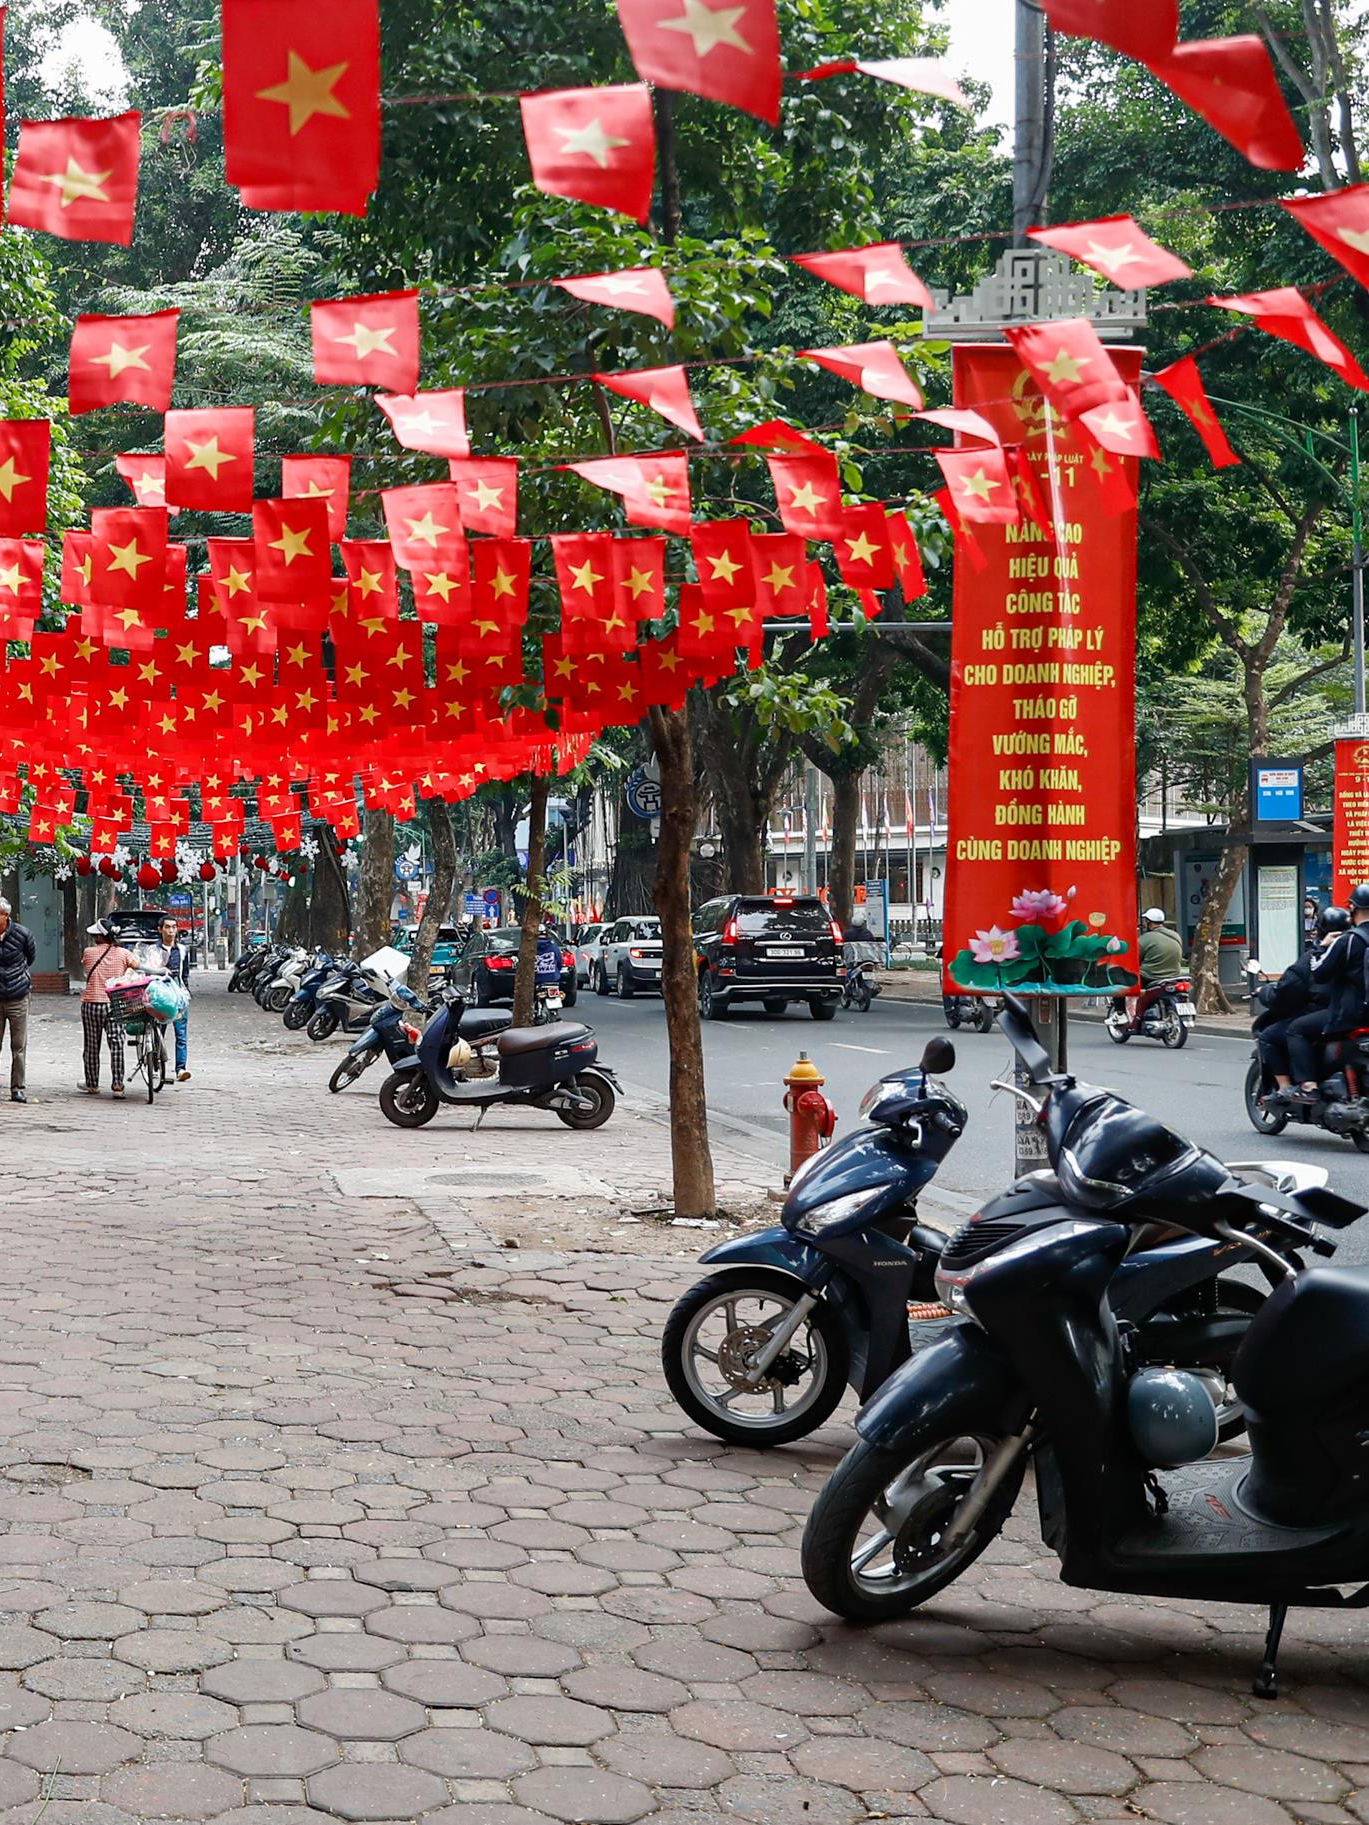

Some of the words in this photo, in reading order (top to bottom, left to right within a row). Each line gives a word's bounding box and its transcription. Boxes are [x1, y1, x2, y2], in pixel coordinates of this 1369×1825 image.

[1057, 521, 1083, 544] CAO
[1009, 552, 1049, 583] HIỆU
[1053, 551, 1079, 581] QUẢ
[1006, 588, 1053, 614] CÔNG
[1057, 588, 1080, 614] TÁC
[982, 622, 1005, 650] HỖ
[1010, 625, 1043, 653] TRỢ
[1048, 624, 1083, 650] PHÁP
[1086, 625, 1104, 650] LÝ
[964, 664, 997, 686] CHO
[1002, 663, 1059, 685] DOANH
[1063, 660, 1116, 690] NGHIỆP,
[1013, 694, 1056, 719] THÁO
[1059, 694, 1078, 720] GỠ
[992, 730, 1051, 756] VƯỚNG
[1054, 726, 1088, 758] MẮC,
[999, 765, 1034, 790] KHÓ
[1039, 765, 1083, 793] KHĂN,
[995, 798, 1042, 825] ĐỒNG
[1047, 800, 1085, 825] HÀNH
[956, 836, 1002, 860] CÙNG
[1007, 840, 1062, 860] DOANH
[1066, 836, 1121, 865] NGHIỆP
